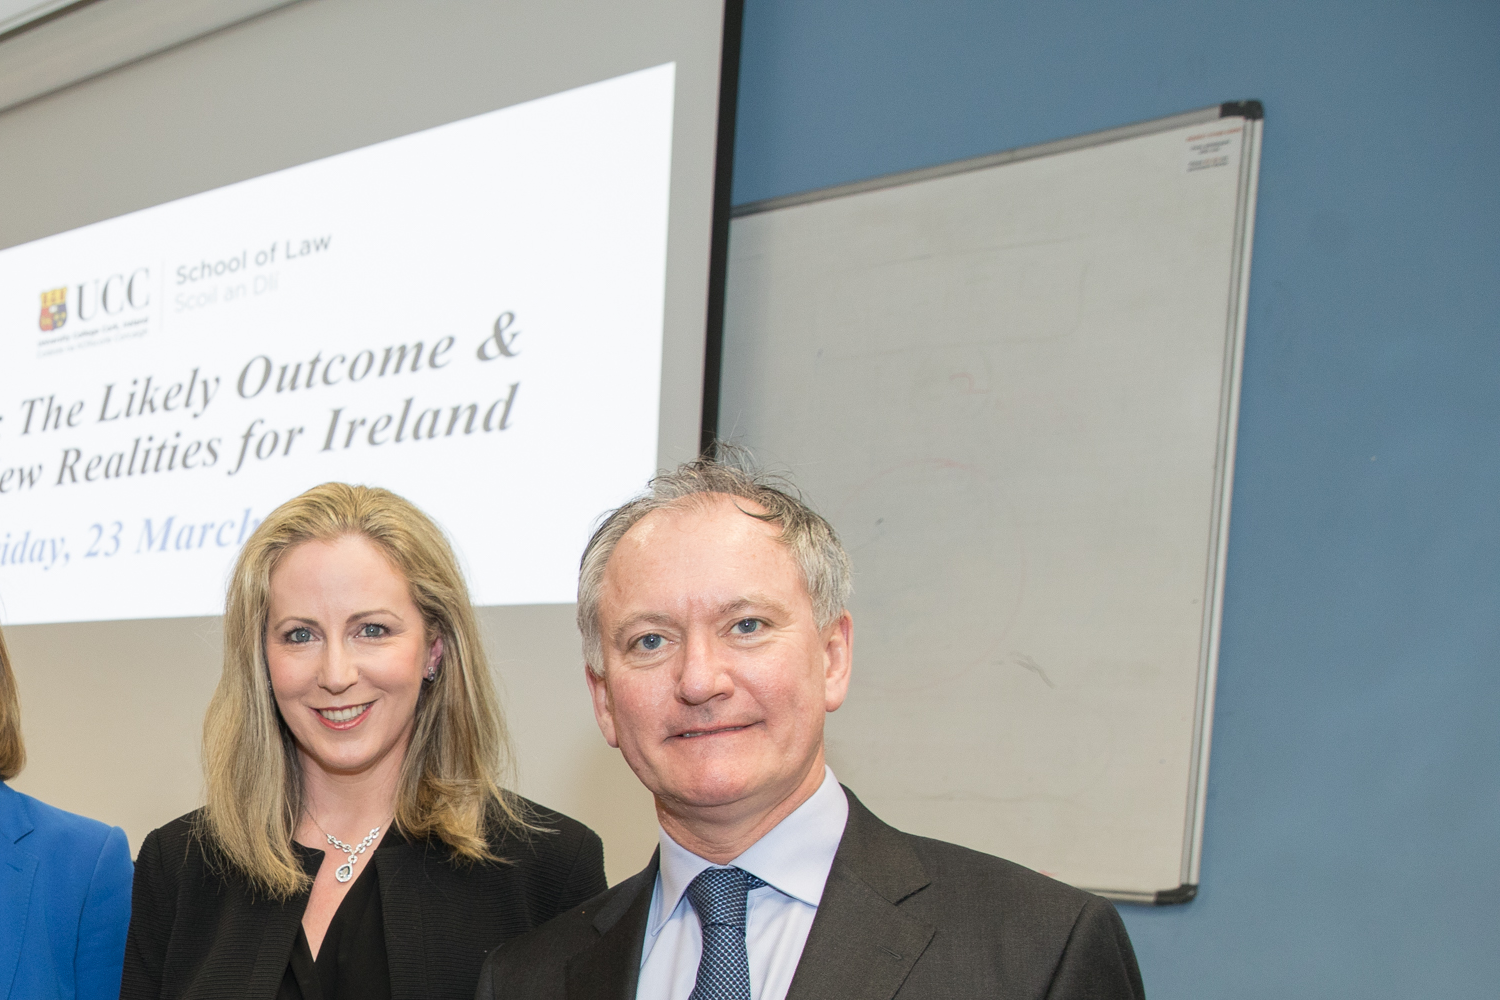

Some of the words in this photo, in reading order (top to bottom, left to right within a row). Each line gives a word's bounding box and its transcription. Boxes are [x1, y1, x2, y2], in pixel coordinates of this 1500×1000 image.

[176, 249, 247, 286] School
[255, 241, 278, 267] of
[285, 234, 332, 261] Law
[77, 267, 150, 322] UCC
[174, 284, 218, 314] Scoil
[223, 282, 247, 303] an
[20, 394, 85, 436] The
[96, 366, 221, 422] Likely
[236, 335, 456, 400] Outcome
[476, 310, 522, 362] &
[55, 432, 223, 487] Realities
[226, 418, 304, 476] for
[320, 382, 521, 452] Ireland
[85, 520, 124, 559] 23
[136, 507, 260, 555] March
